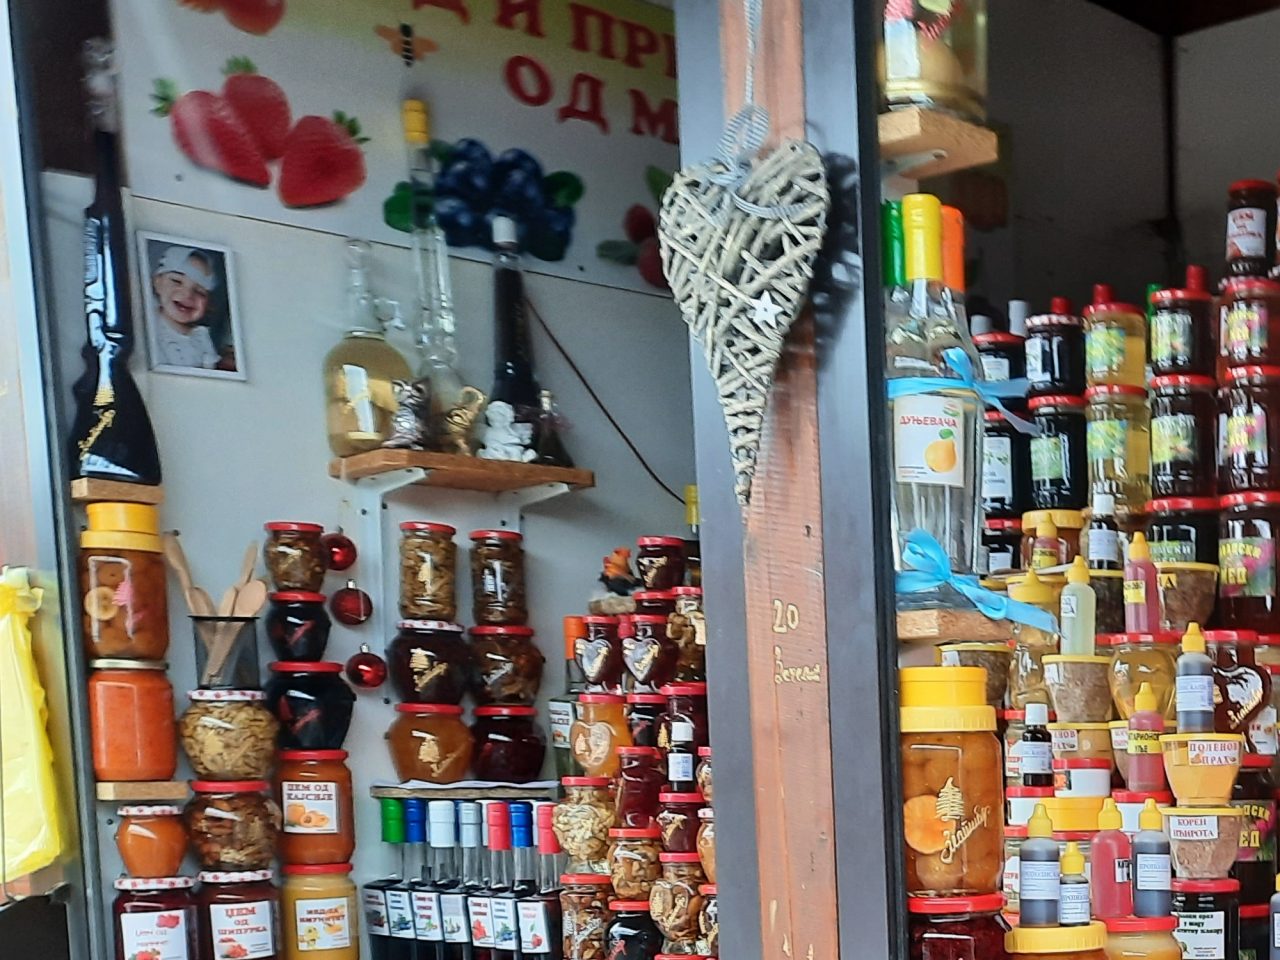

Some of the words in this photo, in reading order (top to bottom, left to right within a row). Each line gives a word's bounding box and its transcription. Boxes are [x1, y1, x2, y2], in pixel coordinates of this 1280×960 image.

[503, 55, 610, 136] ОД
[899, 414, 958, 428] ДУЊЕВАЧА
[1190, 742, 1239, 751] ПОЛЕНОВ
[1202, 757, 1230, 765] ПРАХ
